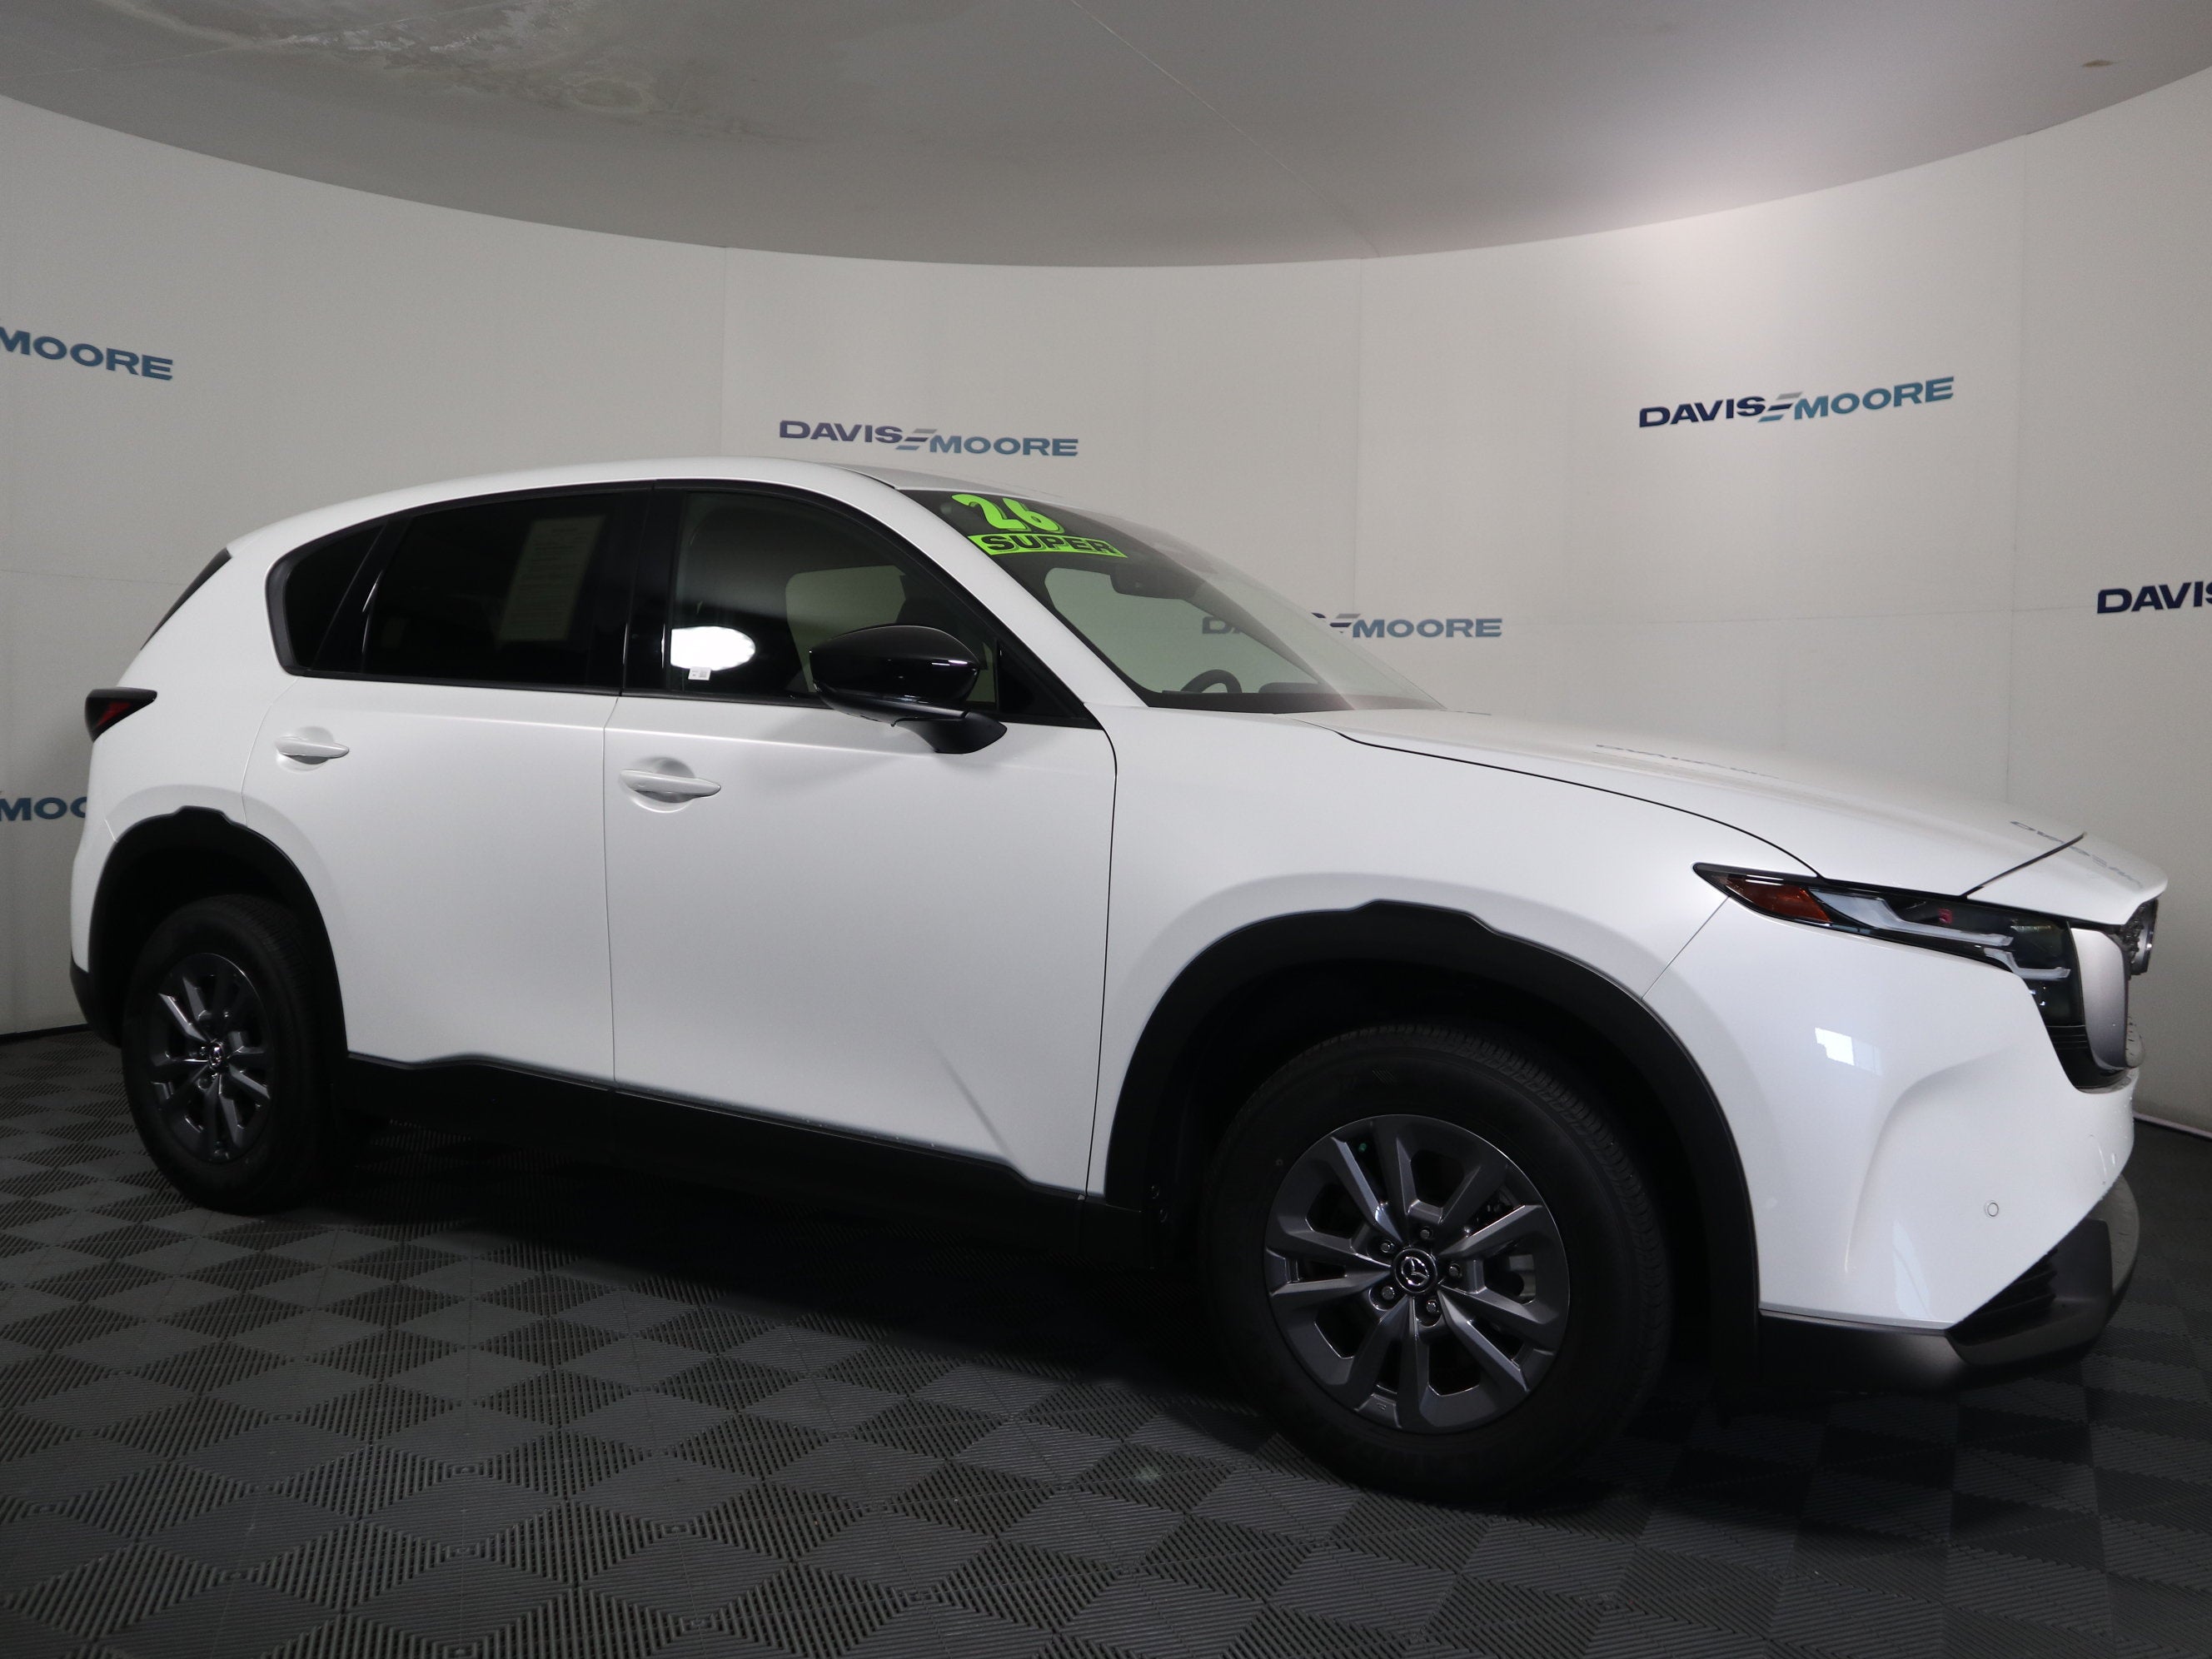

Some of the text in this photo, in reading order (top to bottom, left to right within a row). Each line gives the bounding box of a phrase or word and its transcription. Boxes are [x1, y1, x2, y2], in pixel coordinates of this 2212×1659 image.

[0, 326, 172, 381] MOORE
[1638, 376, 1955, 428] DAVIS MOORE
[779, 420, 1079, 456] DAVIS MOORE
[951, 494, 1065, 534] 26
[980, 535, 1117, 555] SUPER
[2097, 580, 2212, 615] DAVI
[1353, 618, 1502, 638] MOORE
